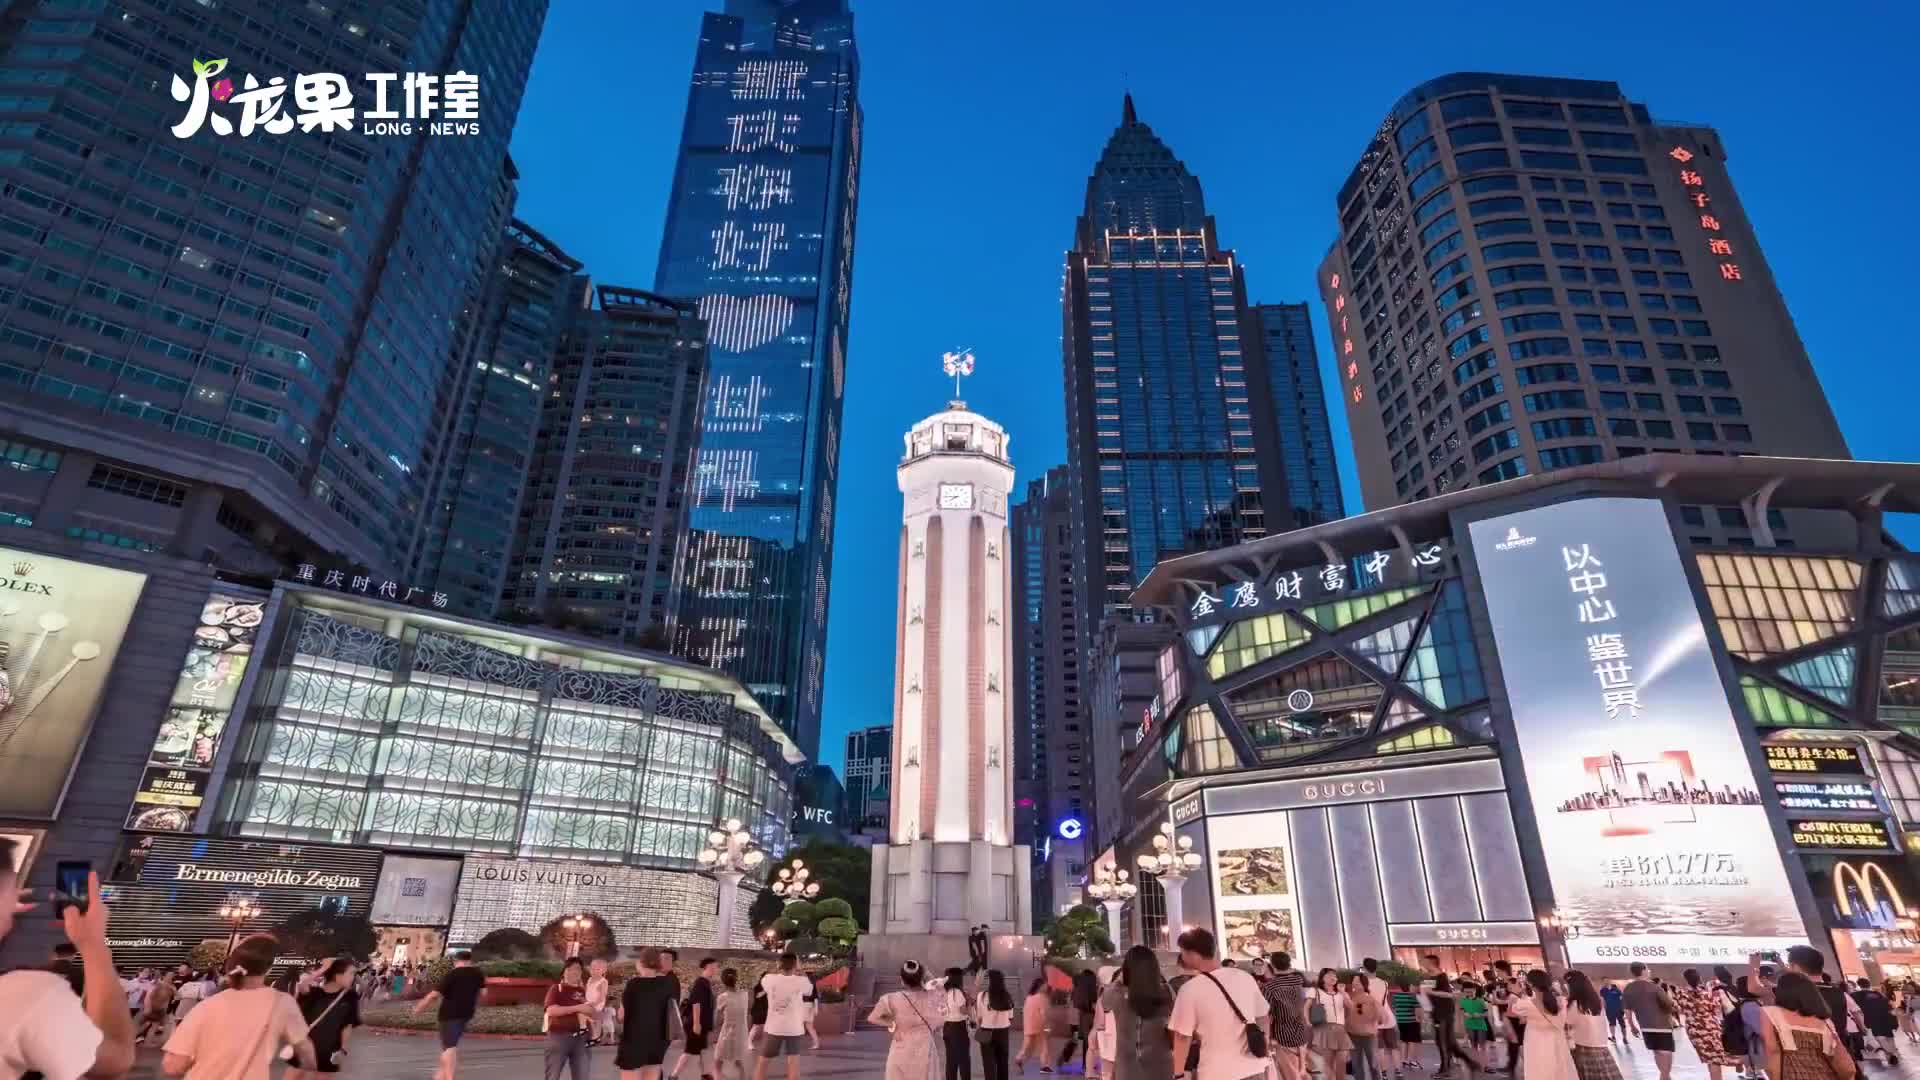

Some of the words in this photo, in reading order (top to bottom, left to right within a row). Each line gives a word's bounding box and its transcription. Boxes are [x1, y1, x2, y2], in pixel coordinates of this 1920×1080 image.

[1680, 170, 1742, 280] 扬子岛酒店
[295, 562, 449, 608] 重庆时代广场
[1191, 545, 1442, 620] 金鹰财富中心
[1562, 543, 1617, 623] 以中心
[1586, 633, 1643, 720] 鉴世界
[1303, 779, 1386, 800] GUCCI
[803, 805, 833, 824] WFC
[1176, 799, 1199, 820] GUCCI
[176, 863, 302, 887] Ermenegildo
[303, 870, 360, 890] Zegna
[476, 866, 528, 882] LOUIS
[536, 871, 608, 886] VUITTON
[1437, 928, 1488, 939] GUCCI
[1596, 946, 1630, 957] 6350
[1632, 946, 1668, 957] 8888
